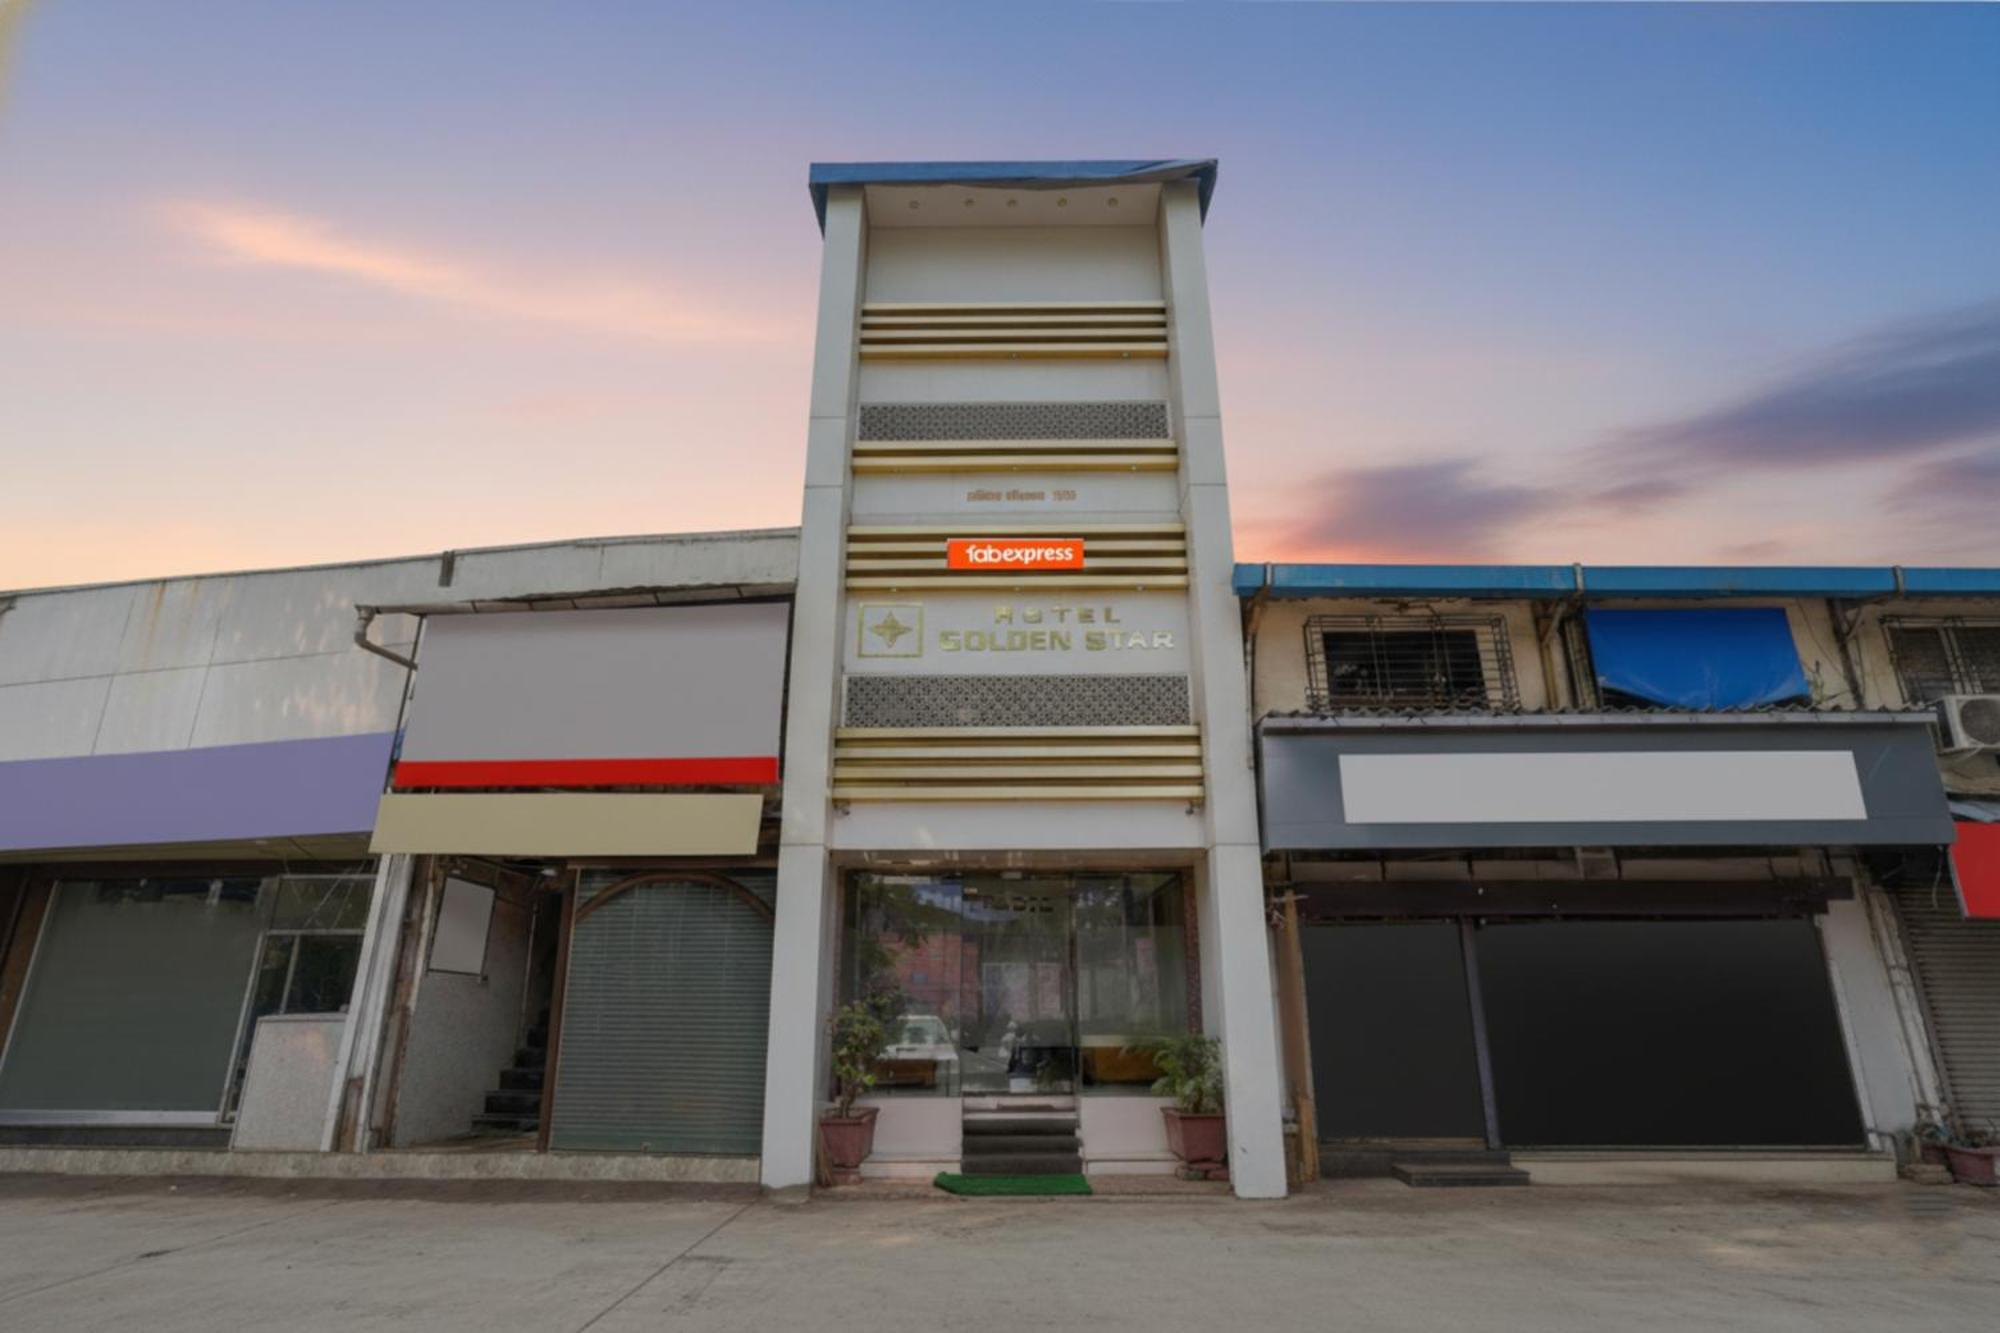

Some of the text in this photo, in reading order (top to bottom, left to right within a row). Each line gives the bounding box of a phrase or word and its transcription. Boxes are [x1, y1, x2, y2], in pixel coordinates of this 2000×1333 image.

[966, 545, 1073, 564] fabexpress
[994, 606, 1121, 624] HOTEL
[938, 630, 1175, 651] GOLDEN STAR
